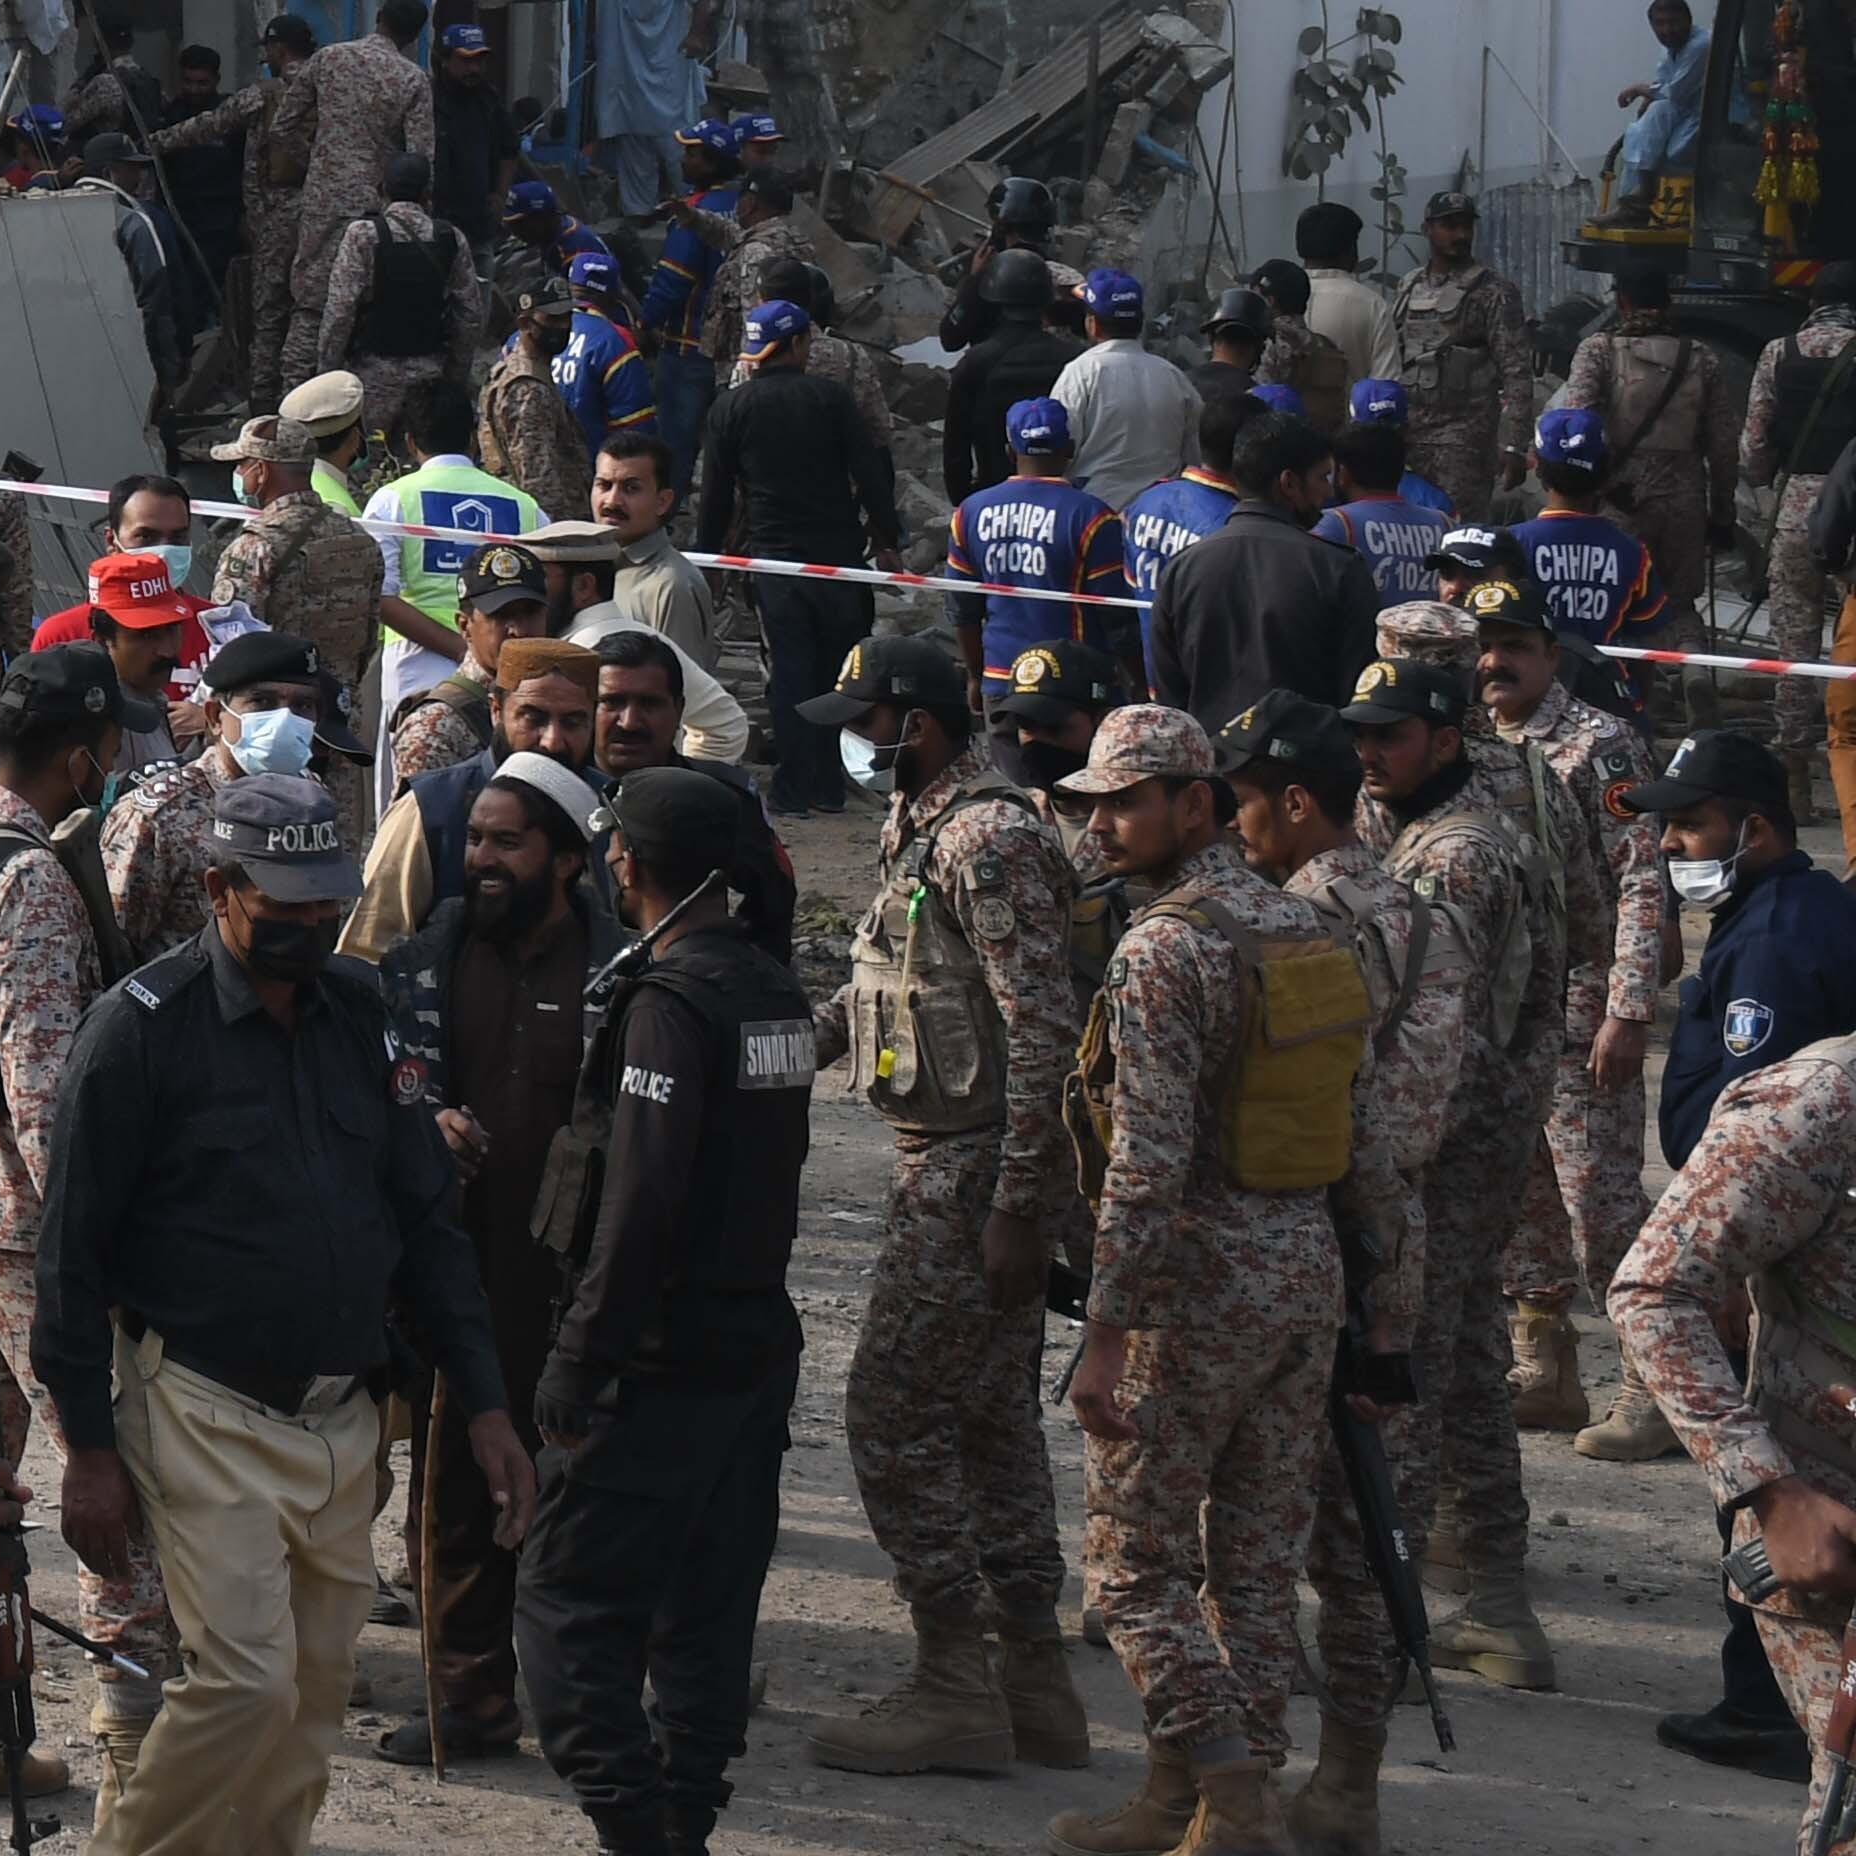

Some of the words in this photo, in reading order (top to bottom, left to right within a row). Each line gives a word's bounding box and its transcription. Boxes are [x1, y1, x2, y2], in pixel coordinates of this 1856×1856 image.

[978, 502, 1056, 544] CHHIPA
[996, 542, 1046, 576] 1020
[1536, 544, 1618, 585] CHHIPA
[130, 576, 169, 601] EDHI
[620, 1065, 675, 1104] POLICE
